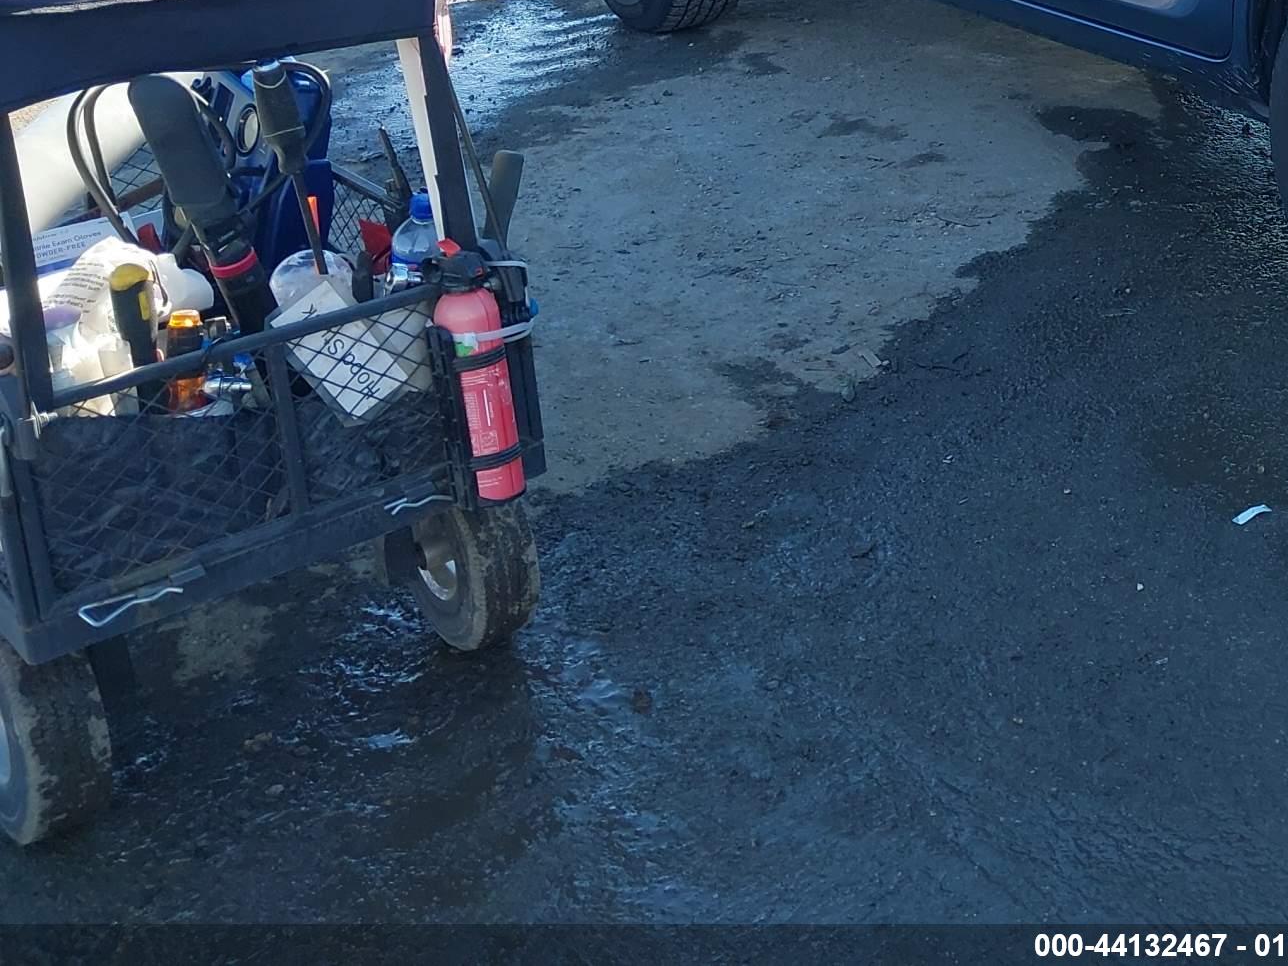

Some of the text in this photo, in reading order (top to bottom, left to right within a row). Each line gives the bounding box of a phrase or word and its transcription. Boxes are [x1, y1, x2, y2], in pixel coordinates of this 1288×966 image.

[52, 237, 73, 248] Exam
[74, 230, 102, 242] Gloves
[35, 241, 87, 260] OWDER-FREE
